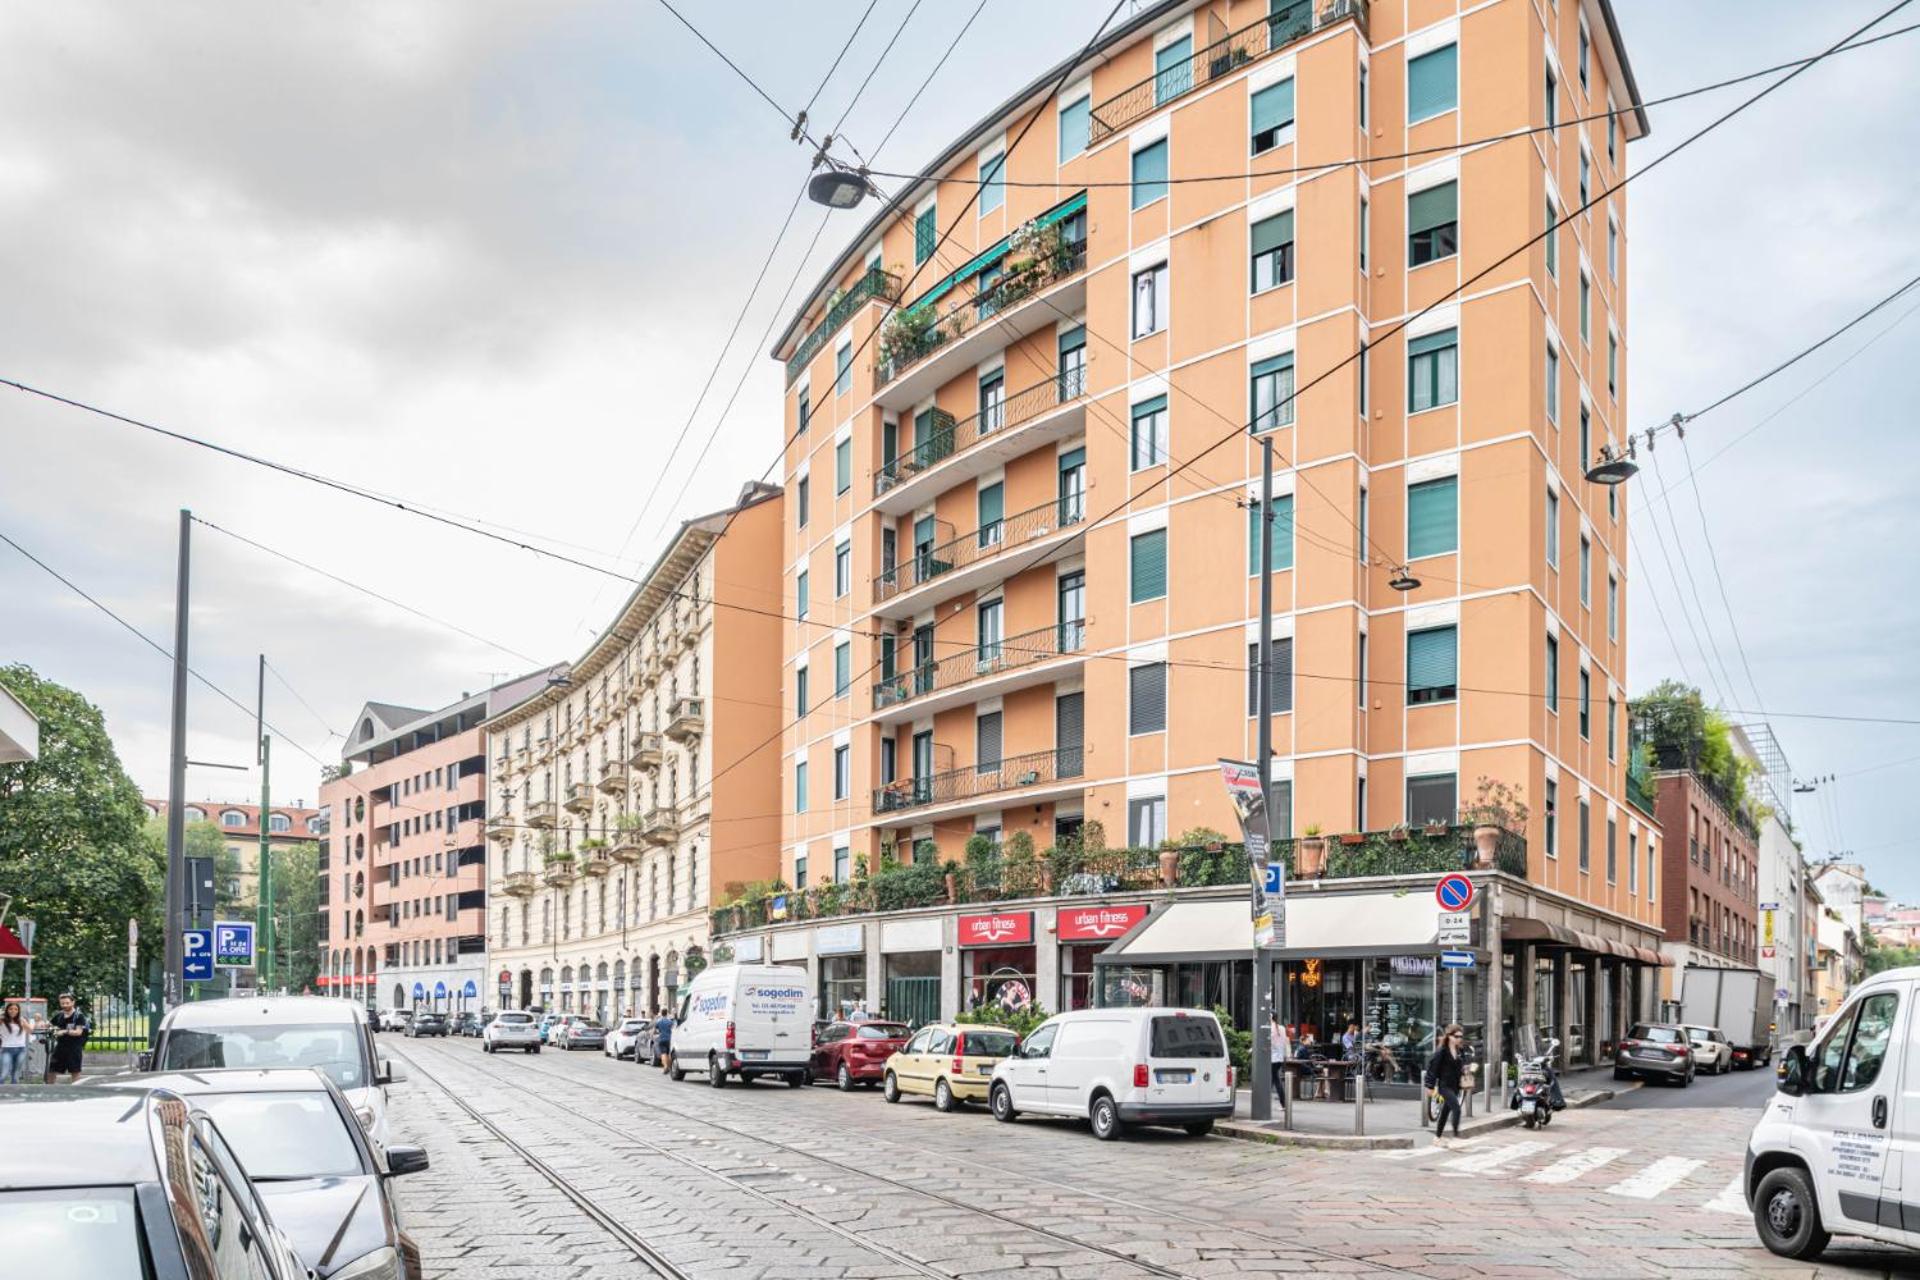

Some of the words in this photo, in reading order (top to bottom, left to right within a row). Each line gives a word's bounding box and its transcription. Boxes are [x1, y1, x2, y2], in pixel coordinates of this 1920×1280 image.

[971, 918, 991, 931] urban
[992, 917, 1016, 929] fitness
[1075, 912, 1098, 925] urban
[1100, 910, 1129, 924] fitness
[183, 933, 205, 957] P
[222, 930, 235, 946] P
[757, 987, 803, 999] sogedim
[699, 996, 727, 1015] sogedim
